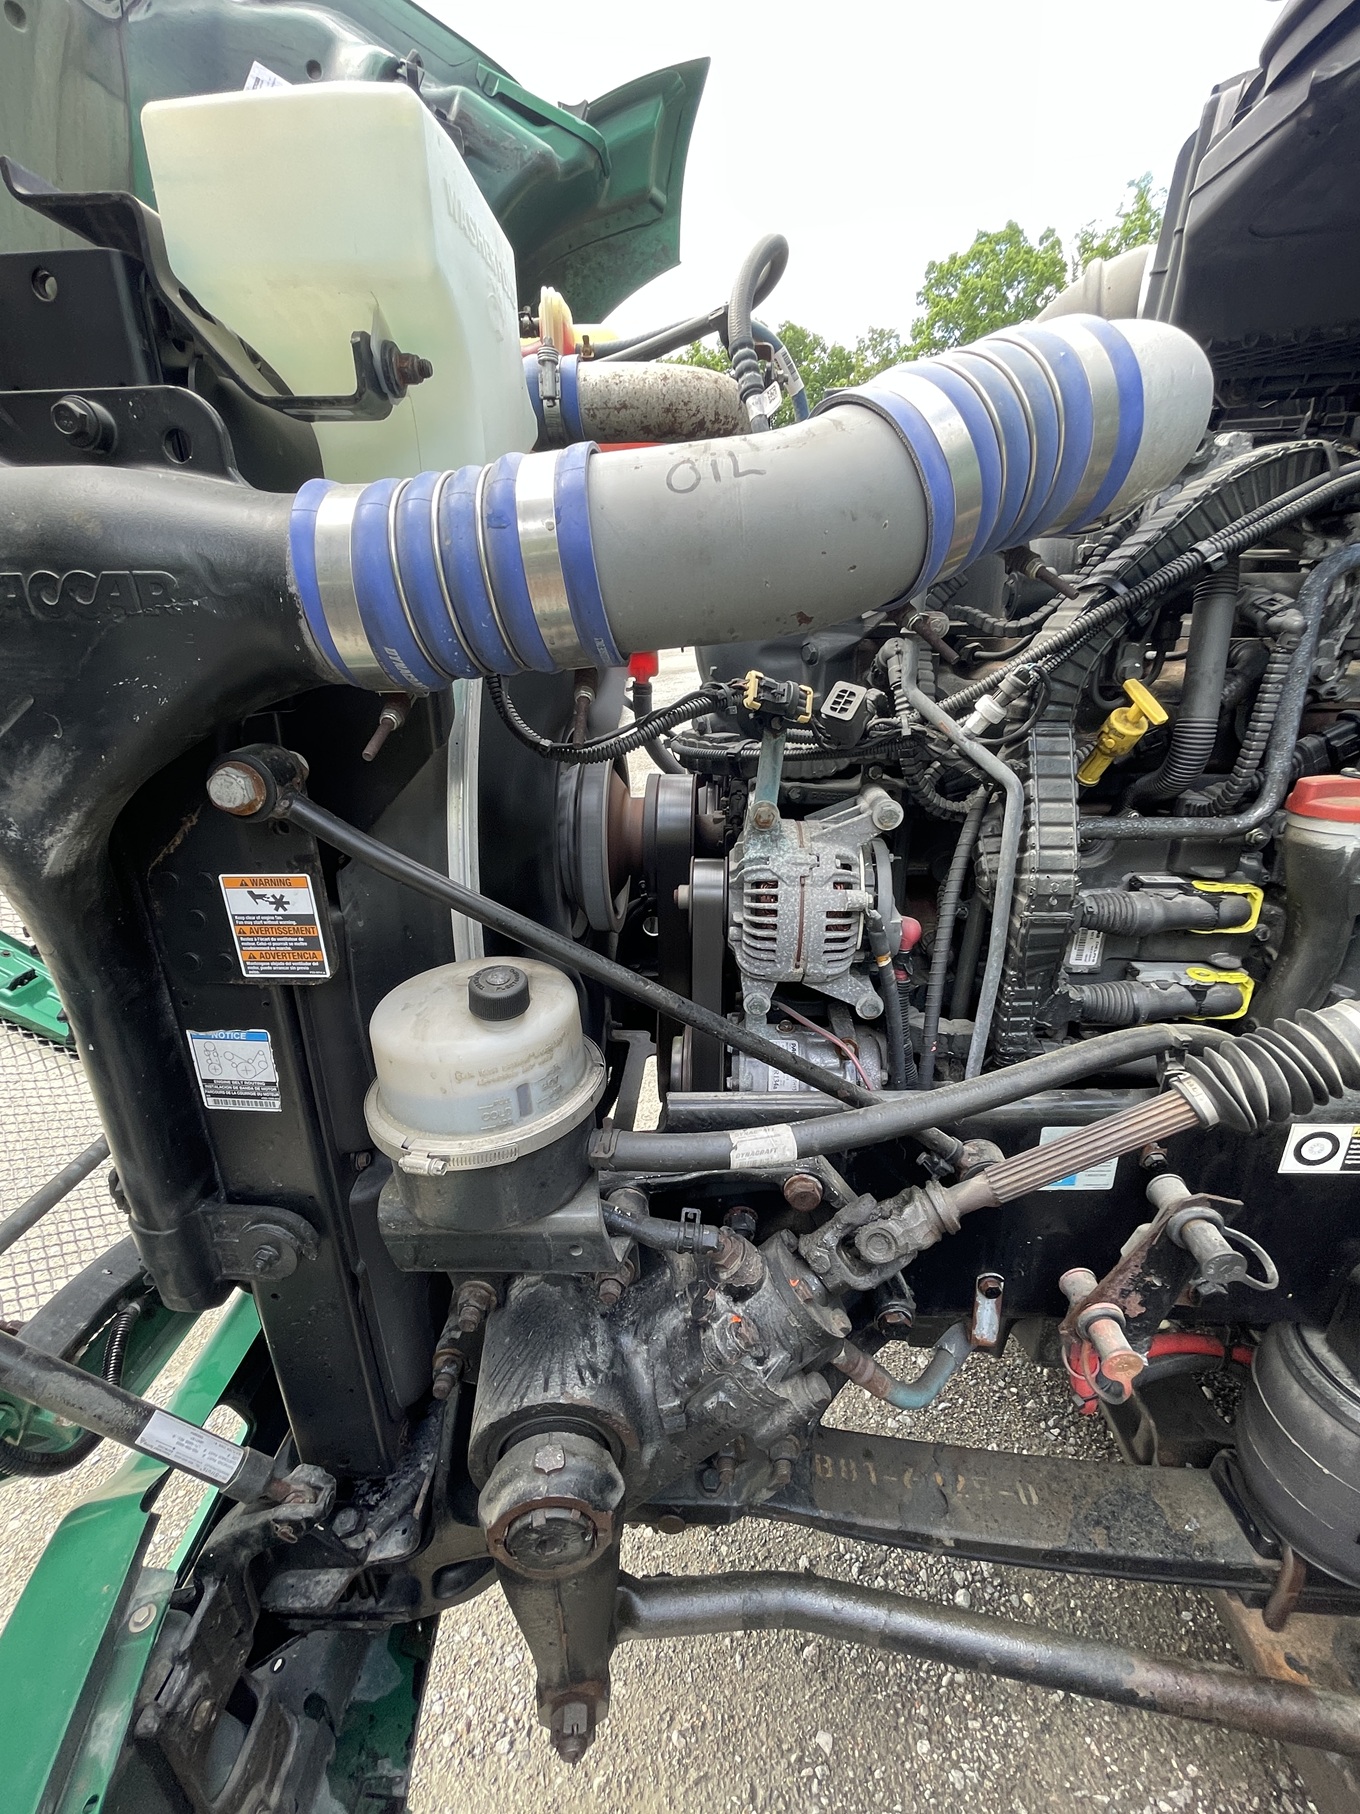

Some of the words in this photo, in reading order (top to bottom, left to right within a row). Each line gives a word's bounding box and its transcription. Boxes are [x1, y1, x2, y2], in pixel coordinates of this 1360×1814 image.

[250, 878, 292, 887] WARNING
[249, 926, 316, 935] AVERTISSEMENT
[260, 952, 318, 960] ADVERTENCIA
